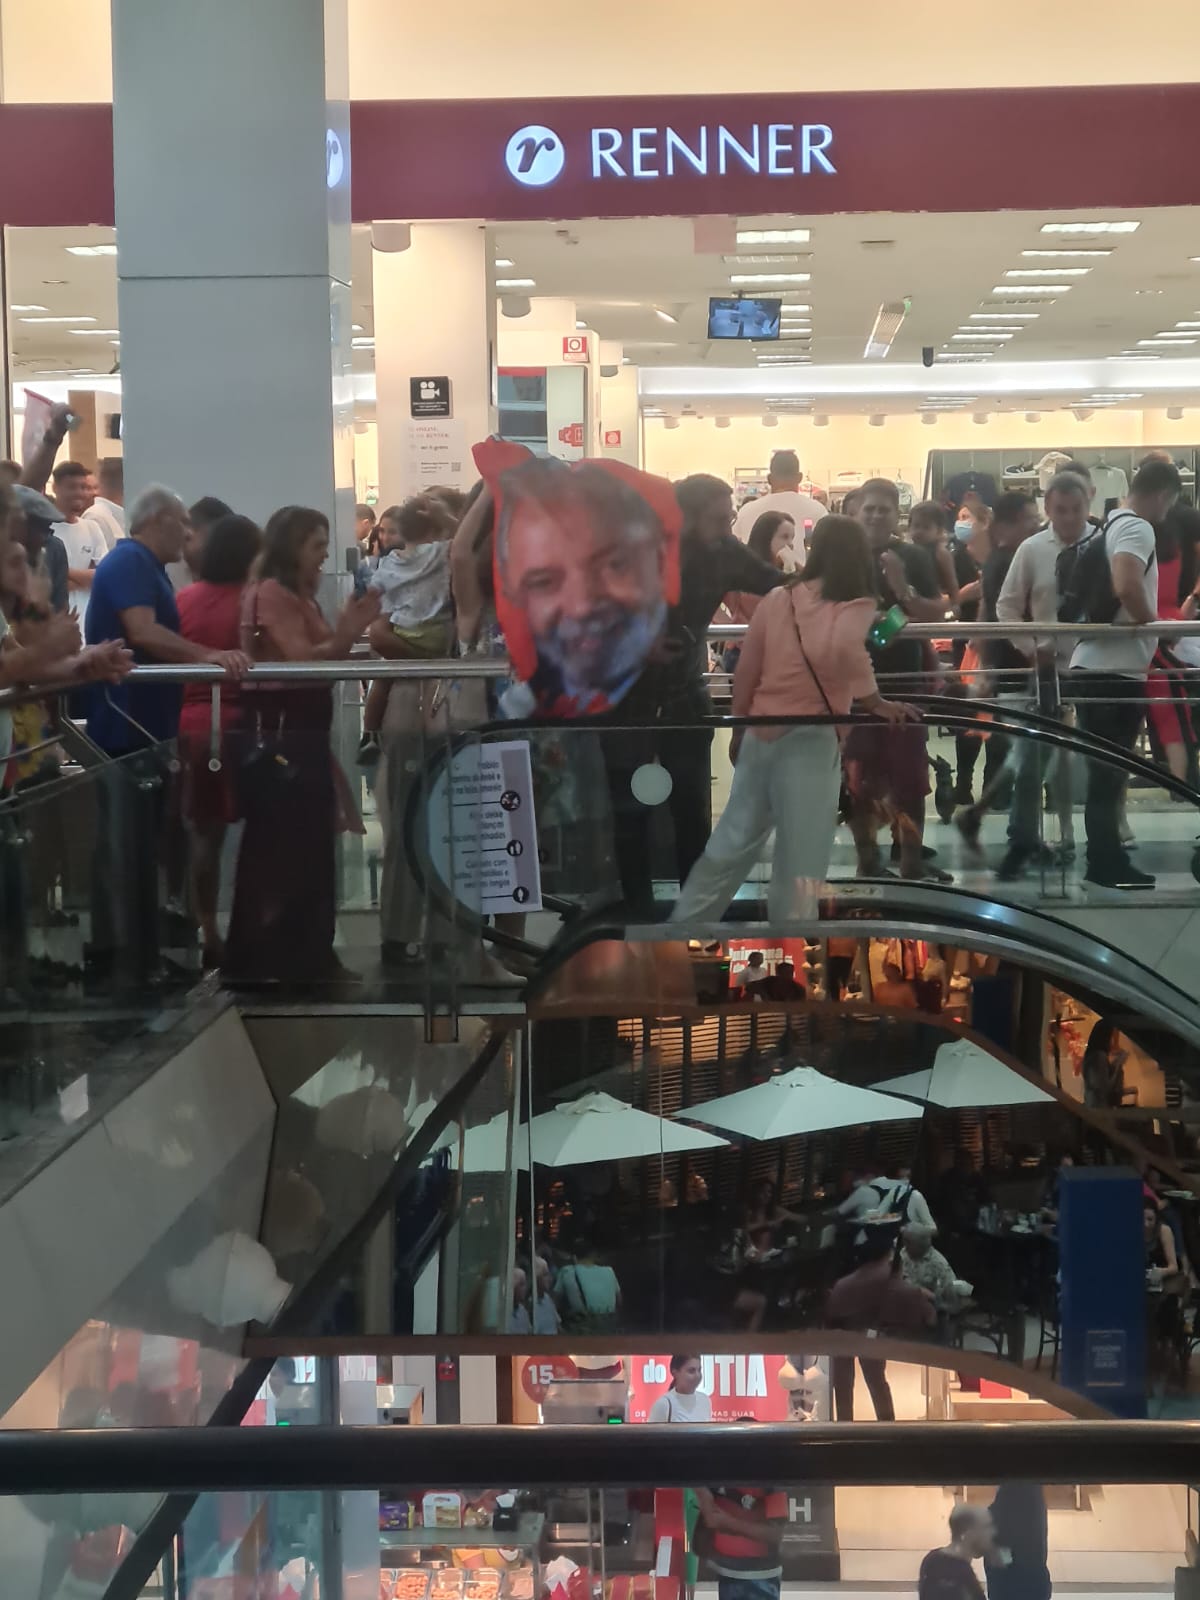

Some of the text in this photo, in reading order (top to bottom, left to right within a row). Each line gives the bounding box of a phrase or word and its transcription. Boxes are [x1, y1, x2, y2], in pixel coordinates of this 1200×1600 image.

[591, 124, 837, 178] RENNER
[528, 1364, 554, 1385] 15
[643, 1355, 768, 1397] do UTIA
[789, 1498, 811, 1522] H
